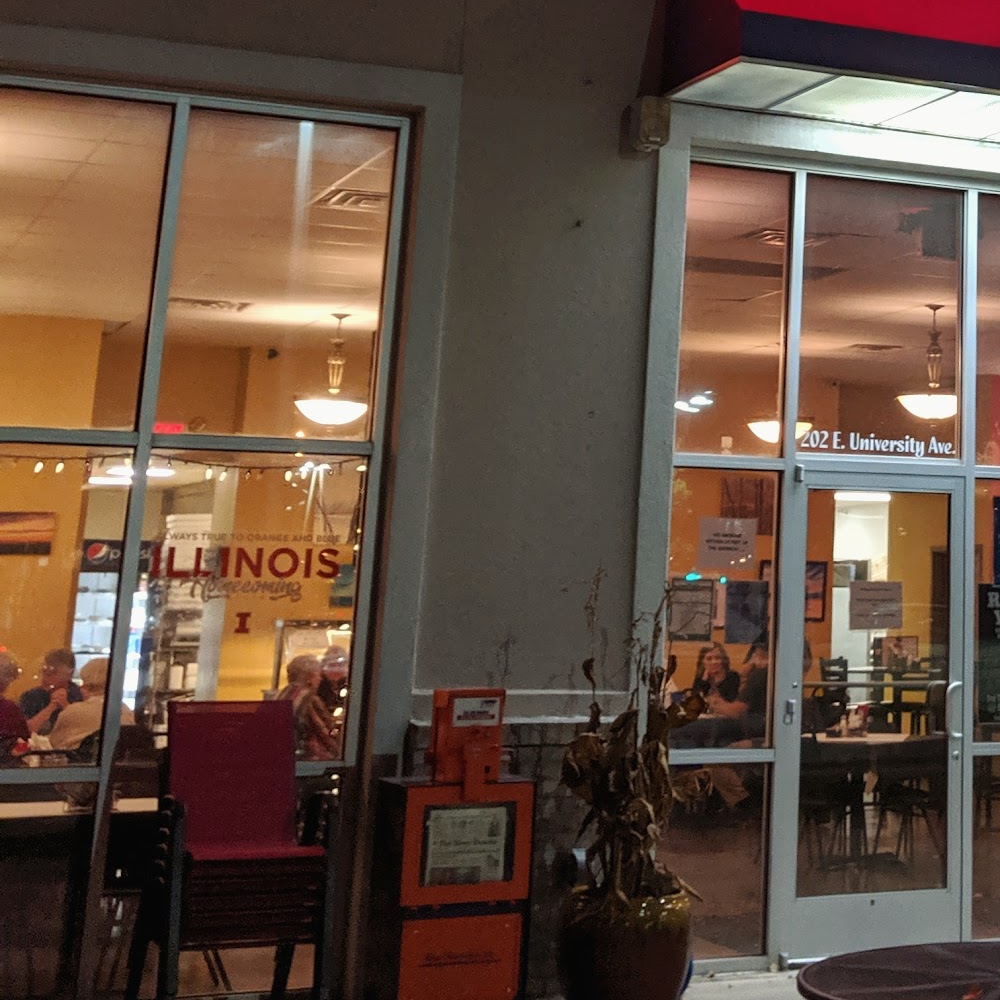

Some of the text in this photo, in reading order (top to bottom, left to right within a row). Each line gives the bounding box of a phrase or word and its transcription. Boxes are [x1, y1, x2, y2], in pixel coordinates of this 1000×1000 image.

[800, 430, 956, 457] 202 E. University Ave.
[149, 546, 340, 578] ILLINOIS
